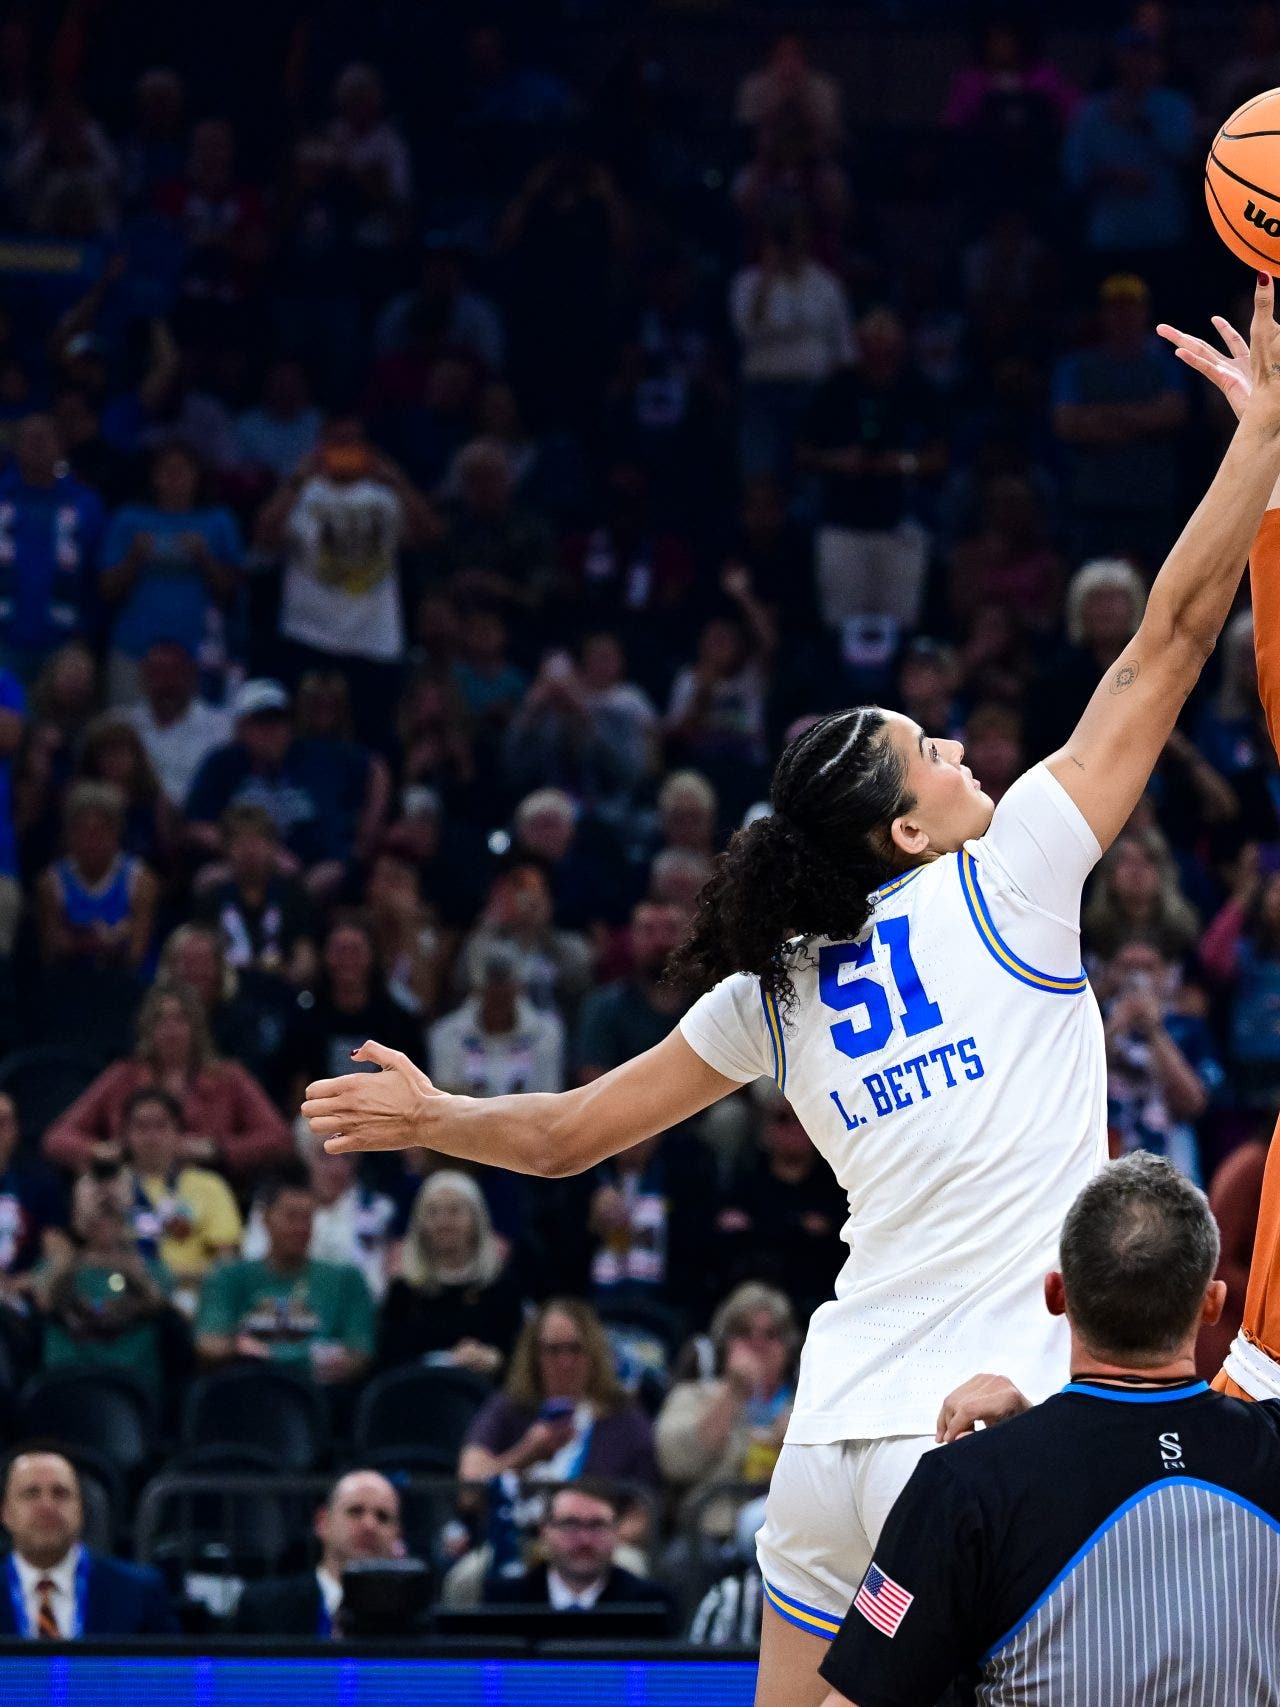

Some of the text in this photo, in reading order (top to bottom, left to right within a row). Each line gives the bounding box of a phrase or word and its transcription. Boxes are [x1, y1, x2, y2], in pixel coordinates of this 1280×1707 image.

[818, 914, 944, 1060] 51
[829, 1036, 985, 1131] L. BETTS
